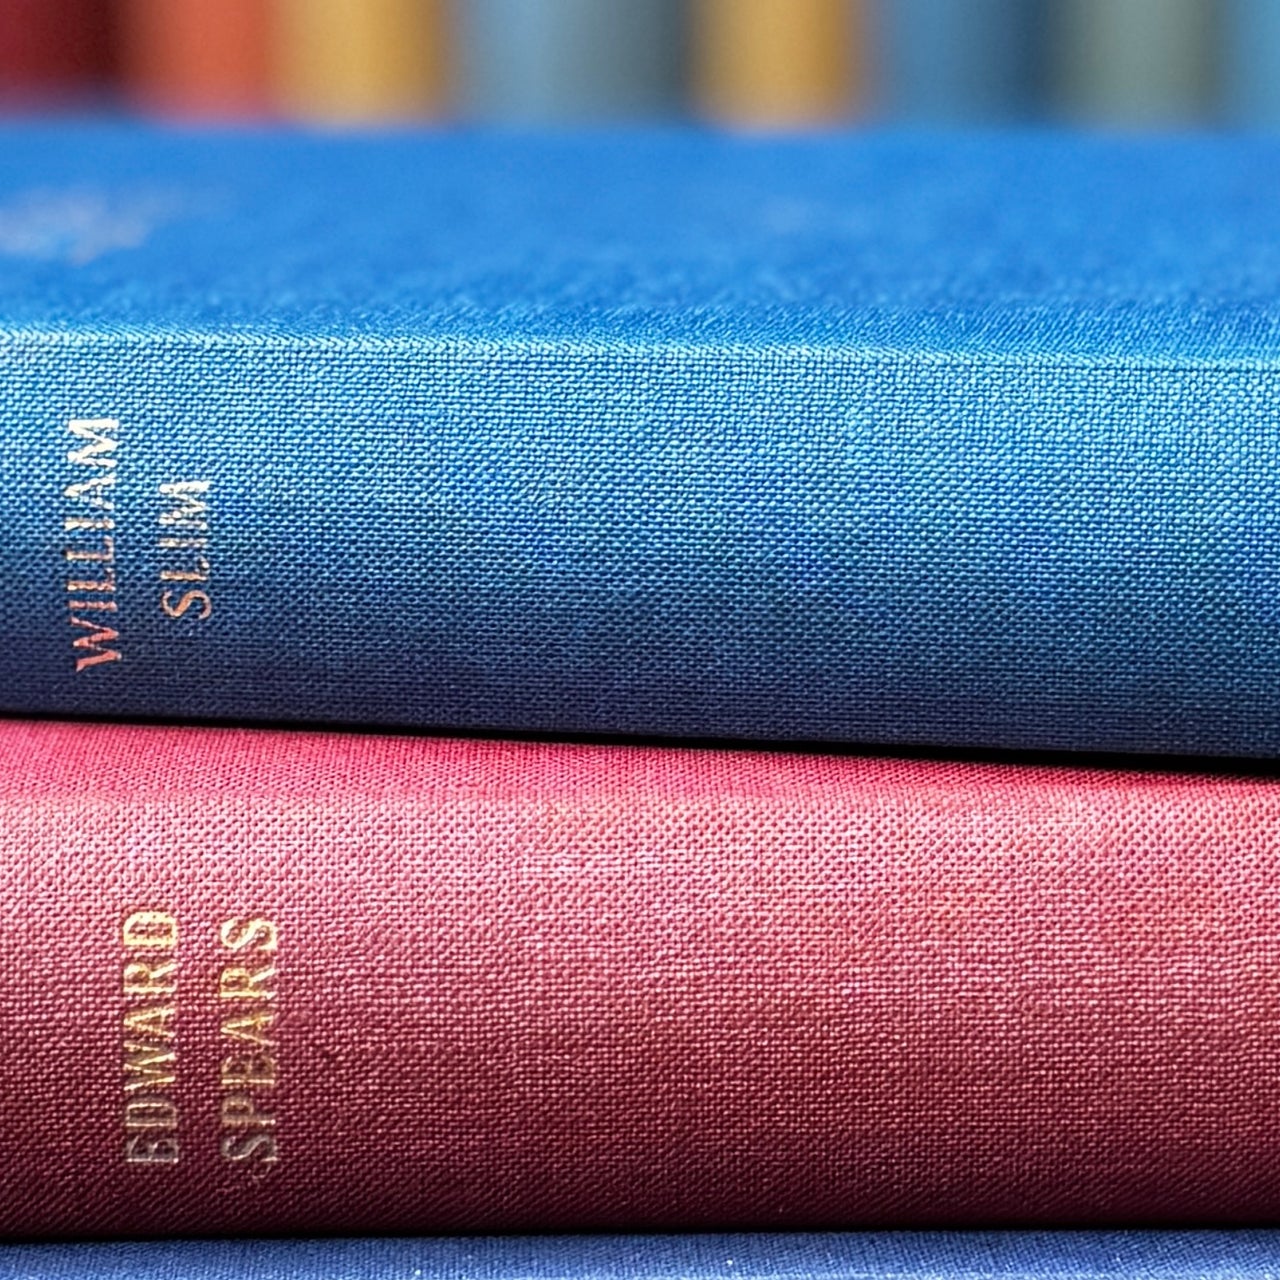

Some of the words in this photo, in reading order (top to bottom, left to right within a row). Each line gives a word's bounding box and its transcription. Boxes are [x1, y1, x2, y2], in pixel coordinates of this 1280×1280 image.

[65, 418, 121, 671] WILLIAM
[158, 480, 211, 620] SLIM
[123, 911, 179, 1163] EDWARD
[220, 919, 277, 1163] SPEARS
